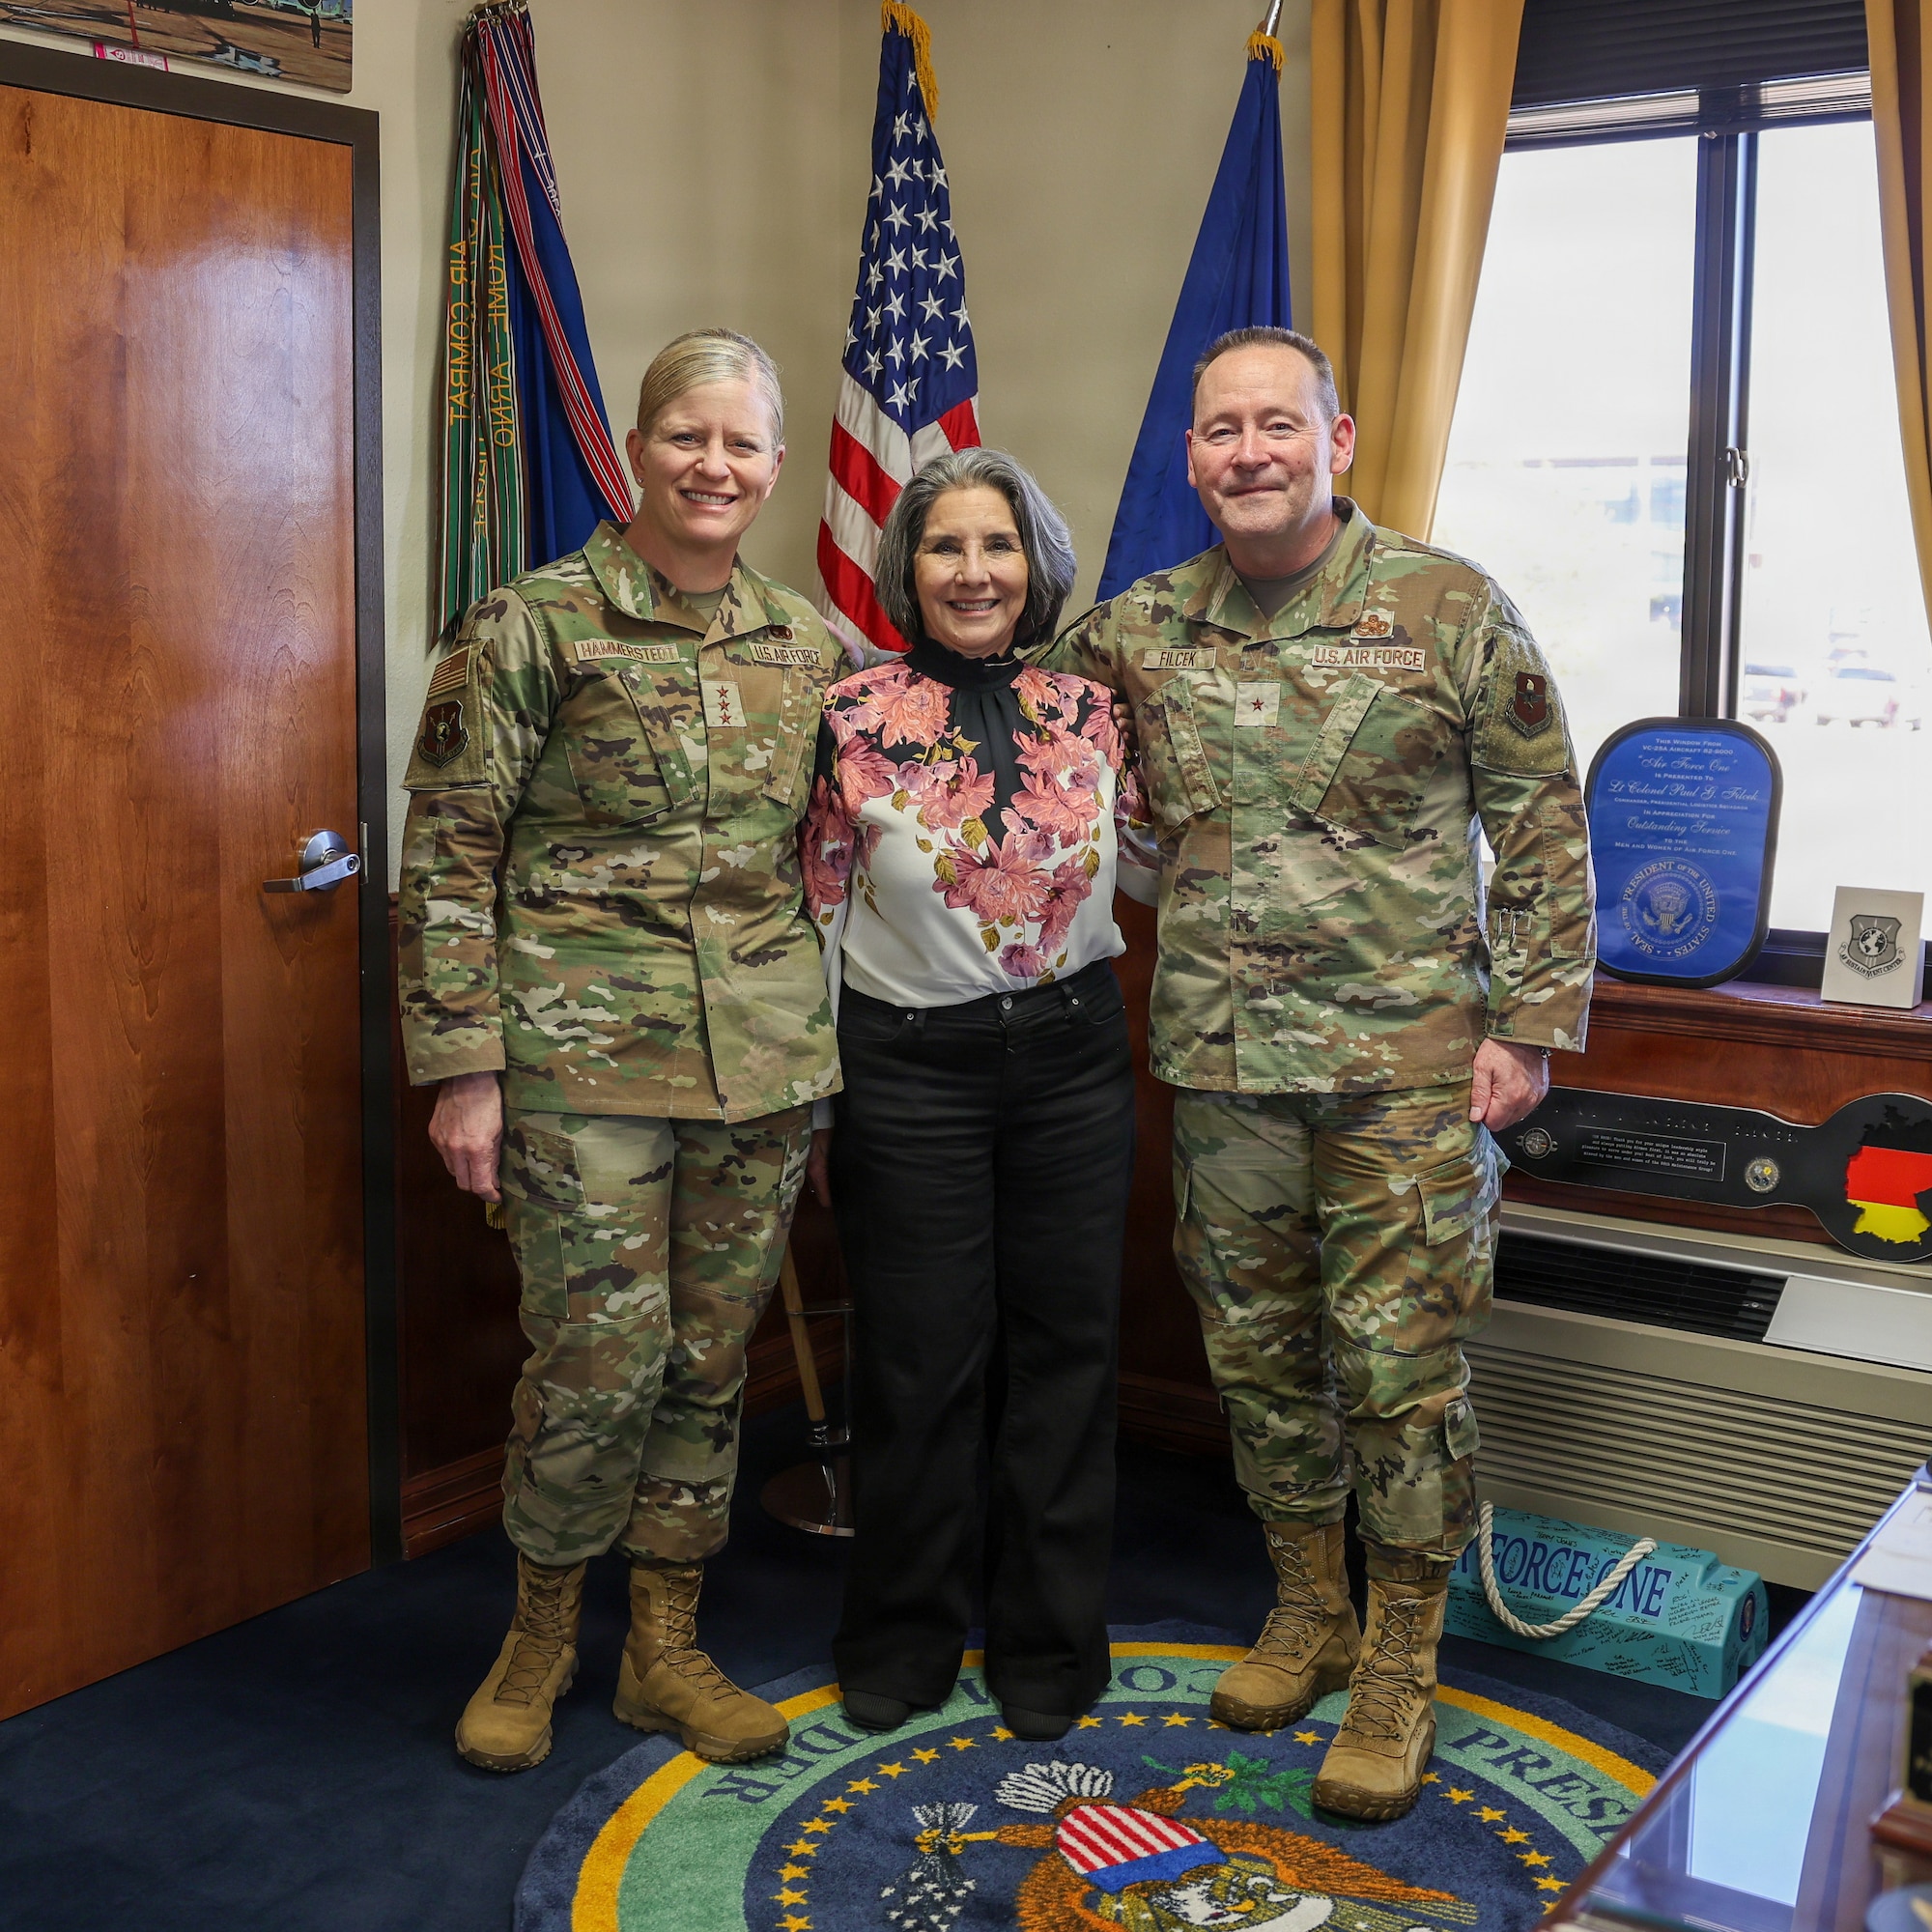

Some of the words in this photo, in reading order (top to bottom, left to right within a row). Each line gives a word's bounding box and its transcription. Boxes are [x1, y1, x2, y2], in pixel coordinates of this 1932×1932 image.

[581, 640, 674, 662] HAMMERSTEDT
[754, 644, 775, 662] U.S.
[774, 648, 792, 664] AIR
[1159, 650, 1197, 668] FILCEK
[1315, 647, 1341, 664] U.S.
[1344, 649, 1370, 666] AIR
[1373, 649, 1422, 668] FORCE
[1628, 781, 1668, 795] Colonel
[1669, 782, 1700, 798] Paul
[1627, 816, 1688, 836] Outstanding
[1690, 820, 1731, 835] Service
[1623, 861, 1675, 901] PRESIDENT
[1699, 878, 1716, 923] UNITED
[1631, 931, 1654, 954] SEAL
[1674, 925, 1710, 957] STATES
[1883, 957, 1903, 973] CENTER
